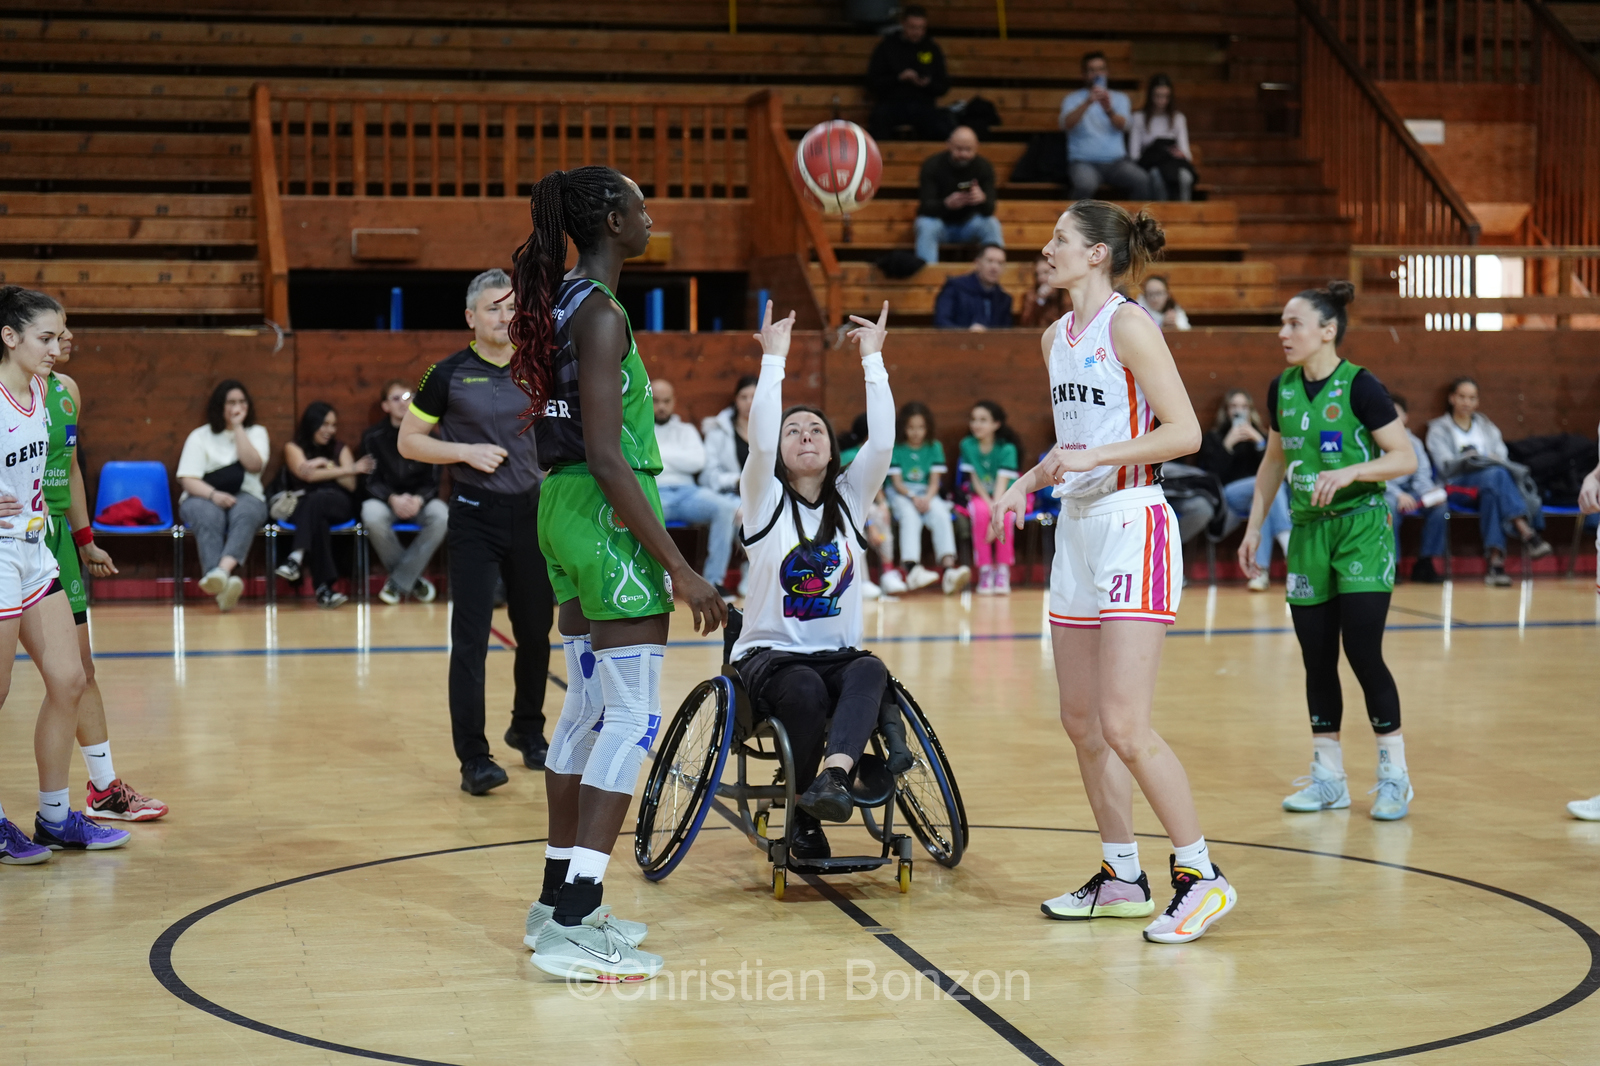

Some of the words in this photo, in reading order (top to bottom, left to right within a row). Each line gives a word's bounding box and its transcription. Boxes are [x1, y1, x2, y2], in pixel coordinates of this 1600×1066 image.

[1052, 383, 1106, 406] ENEVE
[545, 400, 571, 418] ER
[1301, 411, 1310, 431] 6
[1320, 441, 1339, 452] AXA
[45, 468, 66, 477] raites
[31, 478, 42, 512] 2
[1109, 574, 1132, 603] 21
[783, 595, 841, 621] WBL
